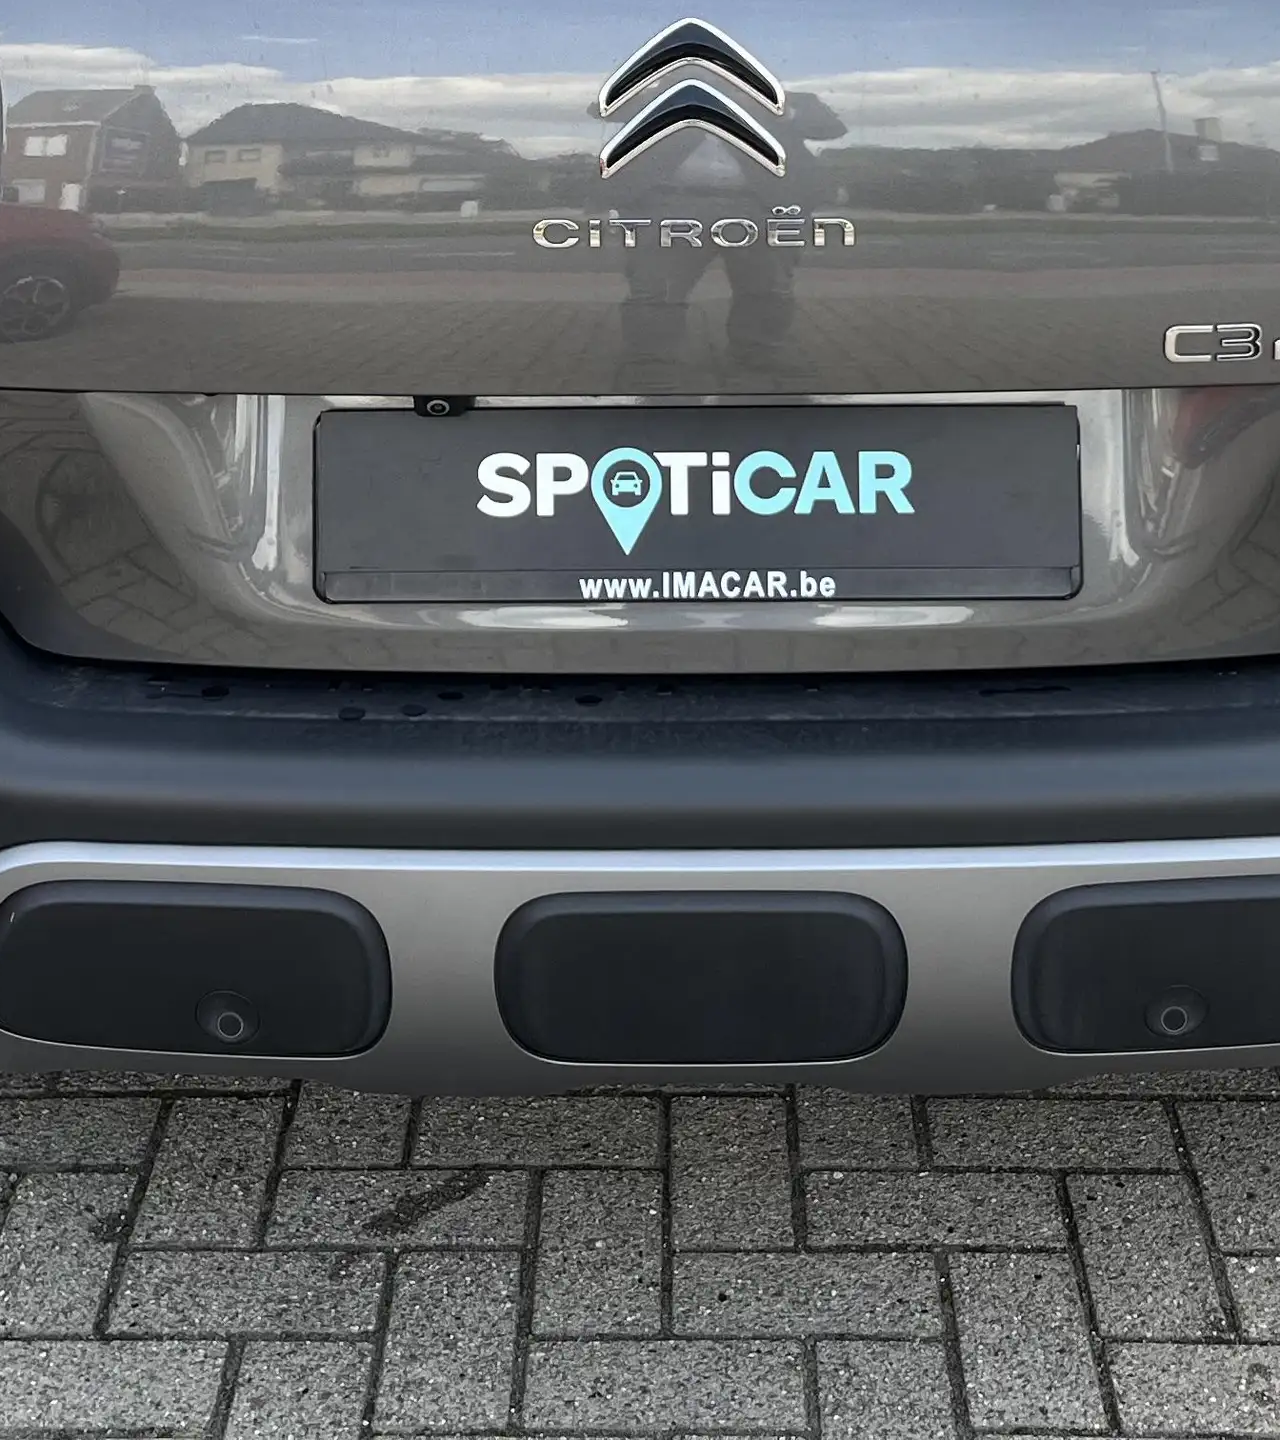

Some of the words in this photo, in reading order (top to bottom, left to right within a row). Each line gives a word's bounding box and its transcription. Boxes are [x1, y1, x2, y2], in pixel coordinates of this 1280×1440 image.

[532, 203, 856, 250] CITROËN
[1164, 322, 1263, 364] C3
[578, 570, 836, 600] www.IMACAR.be
